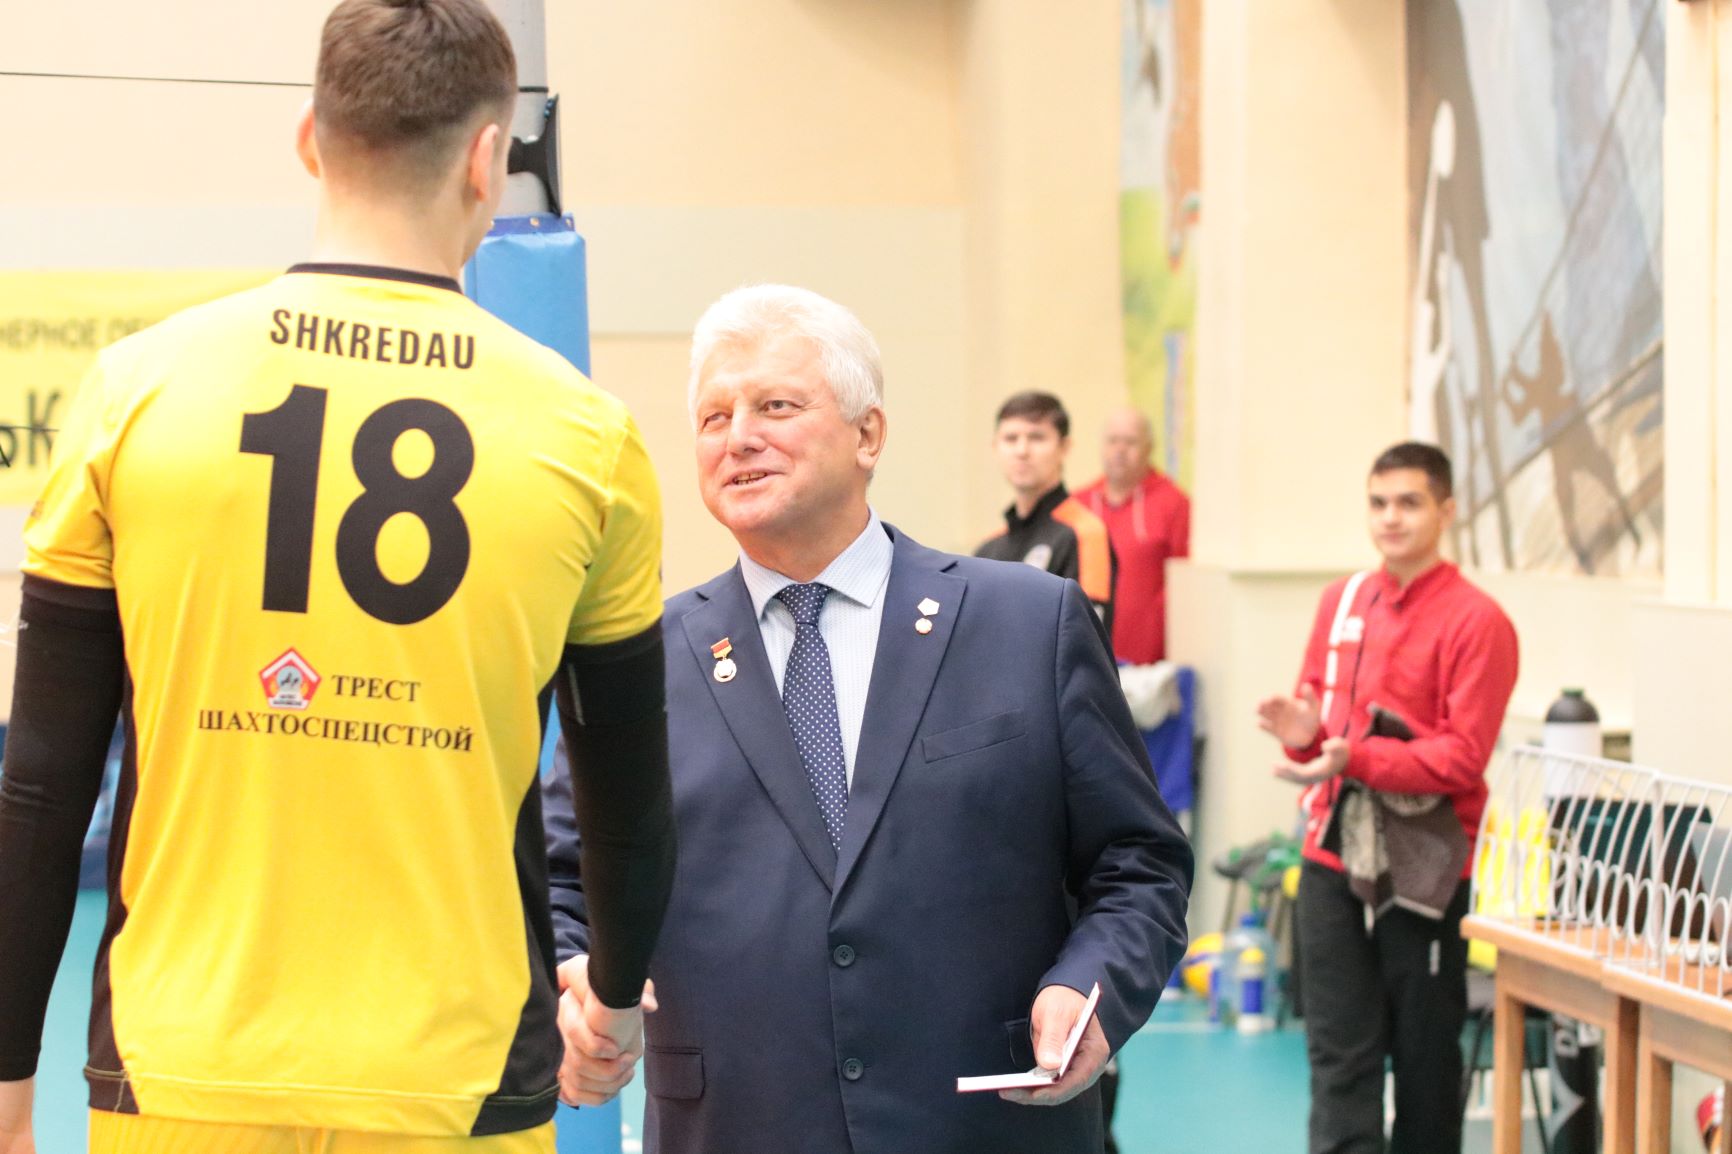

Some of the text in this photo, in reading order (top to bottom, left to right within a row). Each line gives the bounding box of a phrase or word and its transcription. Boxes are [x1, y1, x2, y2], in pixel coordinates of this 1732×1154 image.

[270, 308, 475, 370] SHKREDAU
[239, 384, 476, 625] 18
[331, 674, 421, 703] ТРЕСТ
[198, 709, 474, 752] ШАХТОСПЕЦСТРОЙ
